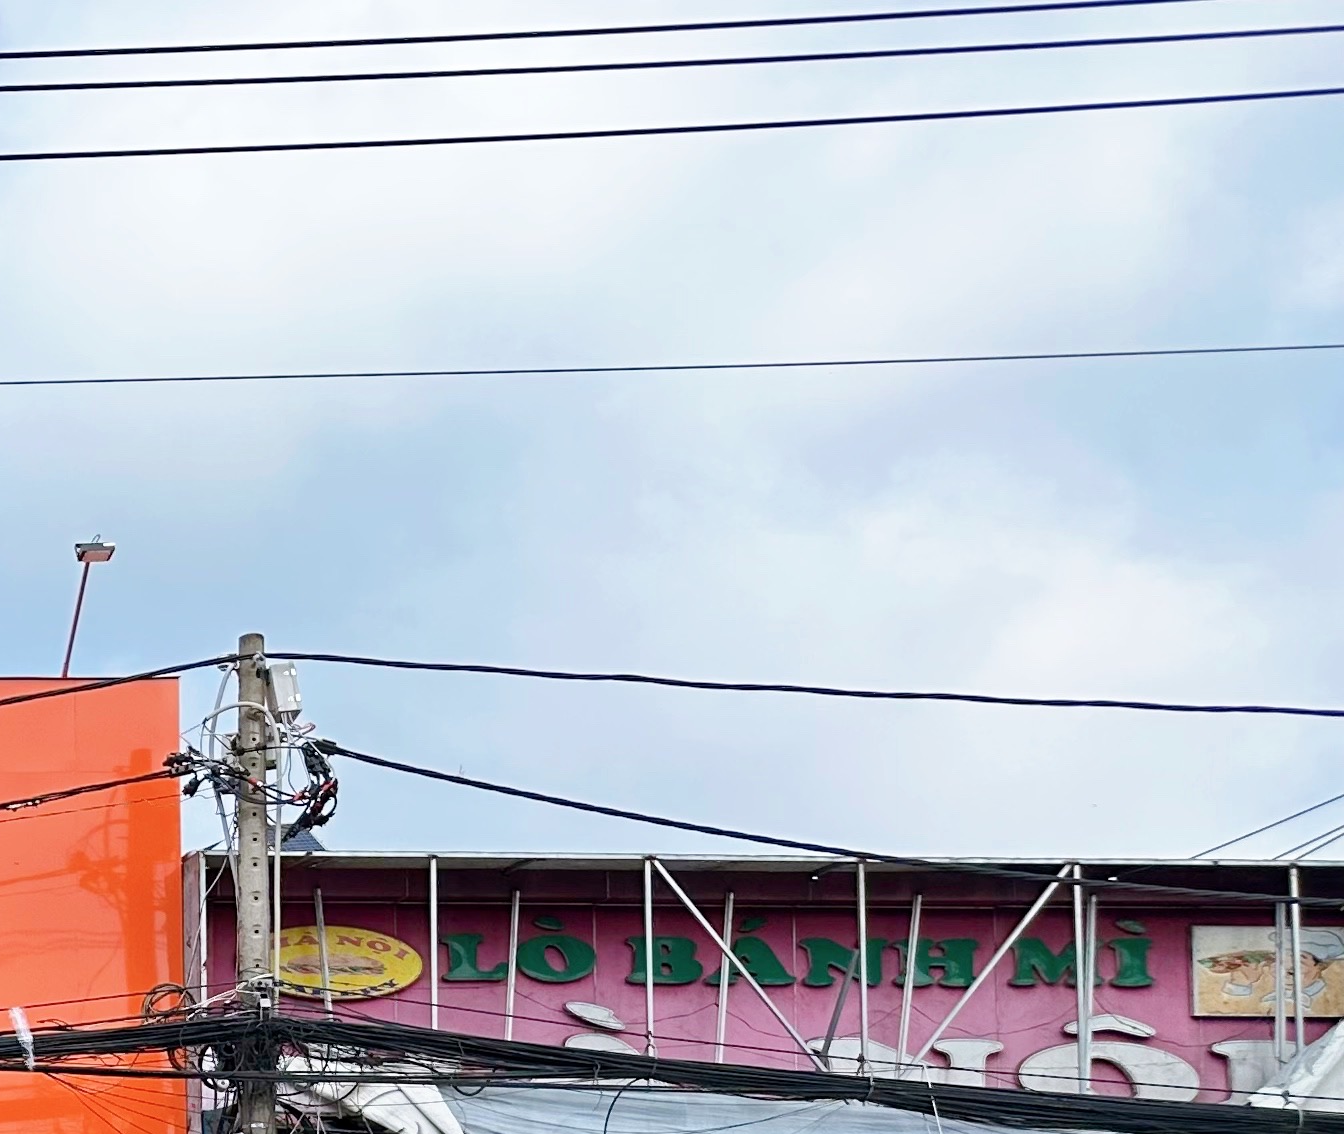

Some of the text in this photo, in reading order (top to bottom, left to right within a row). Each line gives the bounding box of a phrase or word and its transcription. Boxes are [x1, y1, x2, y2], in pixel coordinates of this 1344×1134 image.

[335, 934, 411, 961] NỘI
[440, 915, 1157, 990] LÒ BÁNH MÌ
